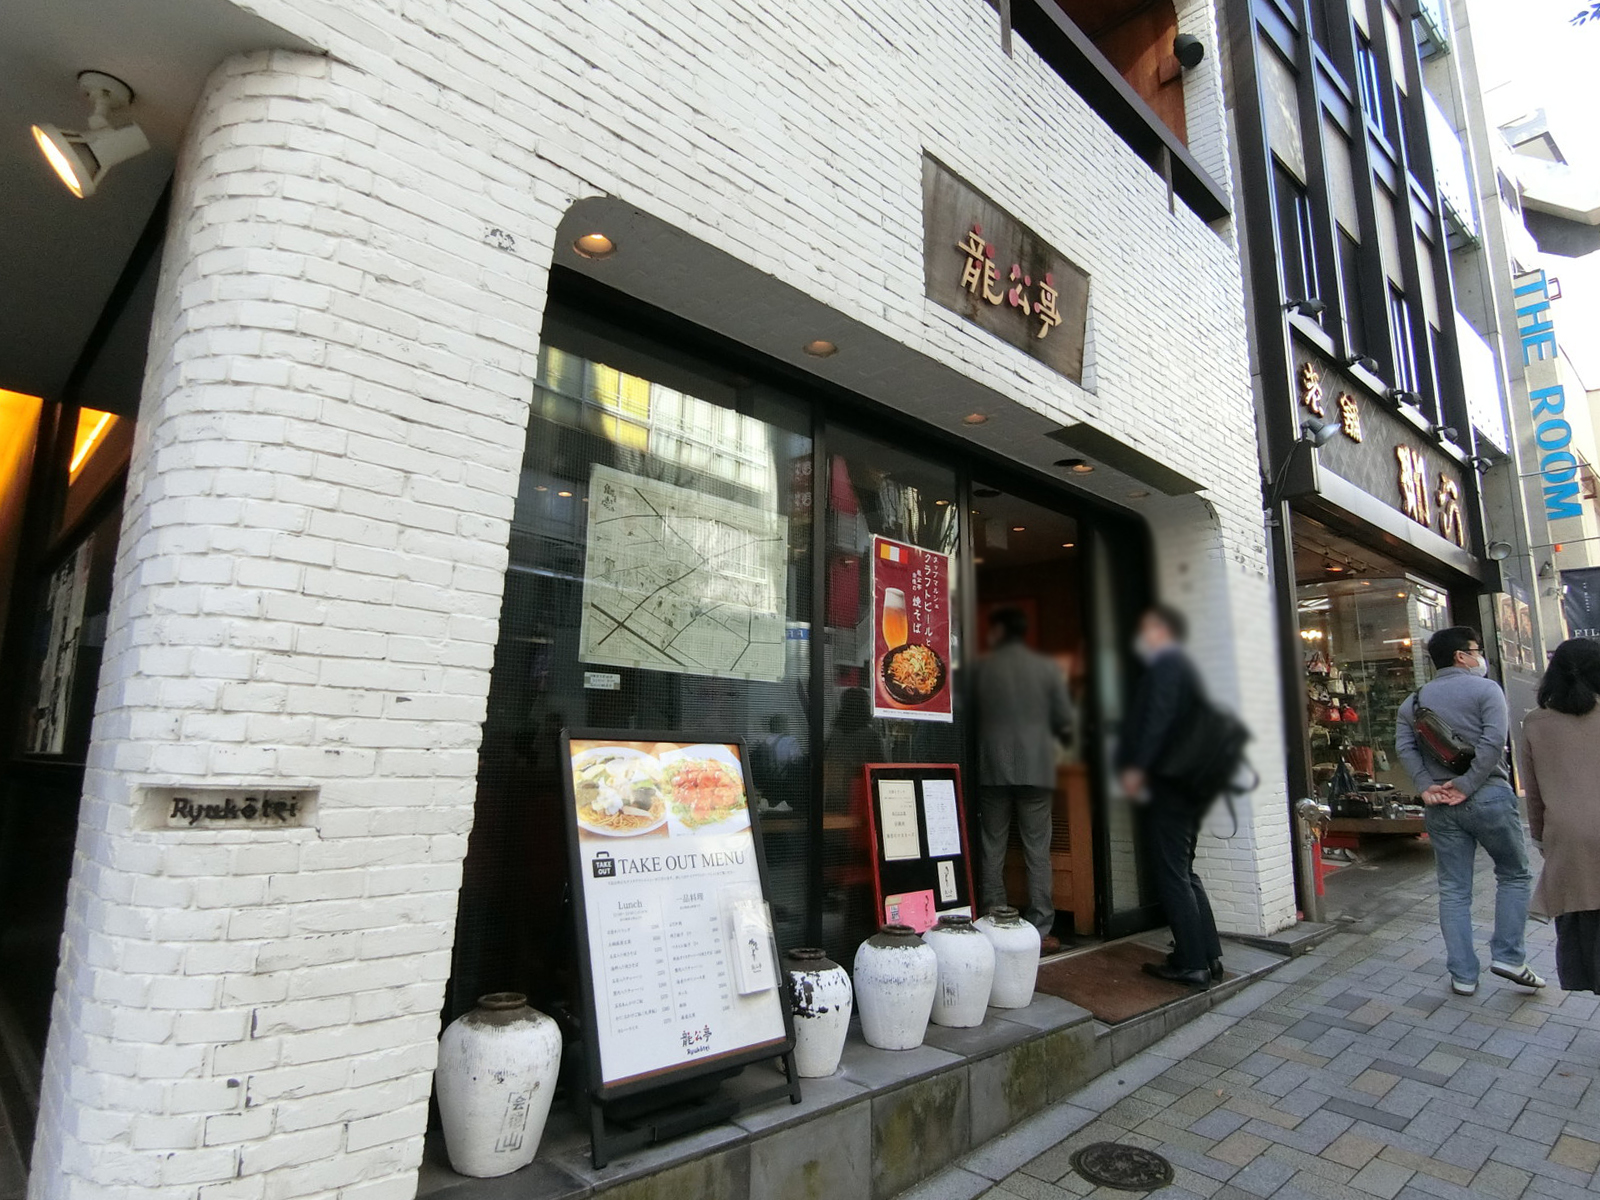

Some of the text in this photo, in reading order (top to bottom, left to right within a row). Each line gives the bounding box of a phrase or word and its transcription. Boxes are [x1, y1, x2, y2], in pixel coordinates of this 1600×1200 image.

[957, 224, 1063, 339] 龍公亭
[1513, 269, 1583, 521] THE ROOM
[618, 851, 745, 874] TAKE OUT MENU
[617, 899, 643, 910] Lunch
